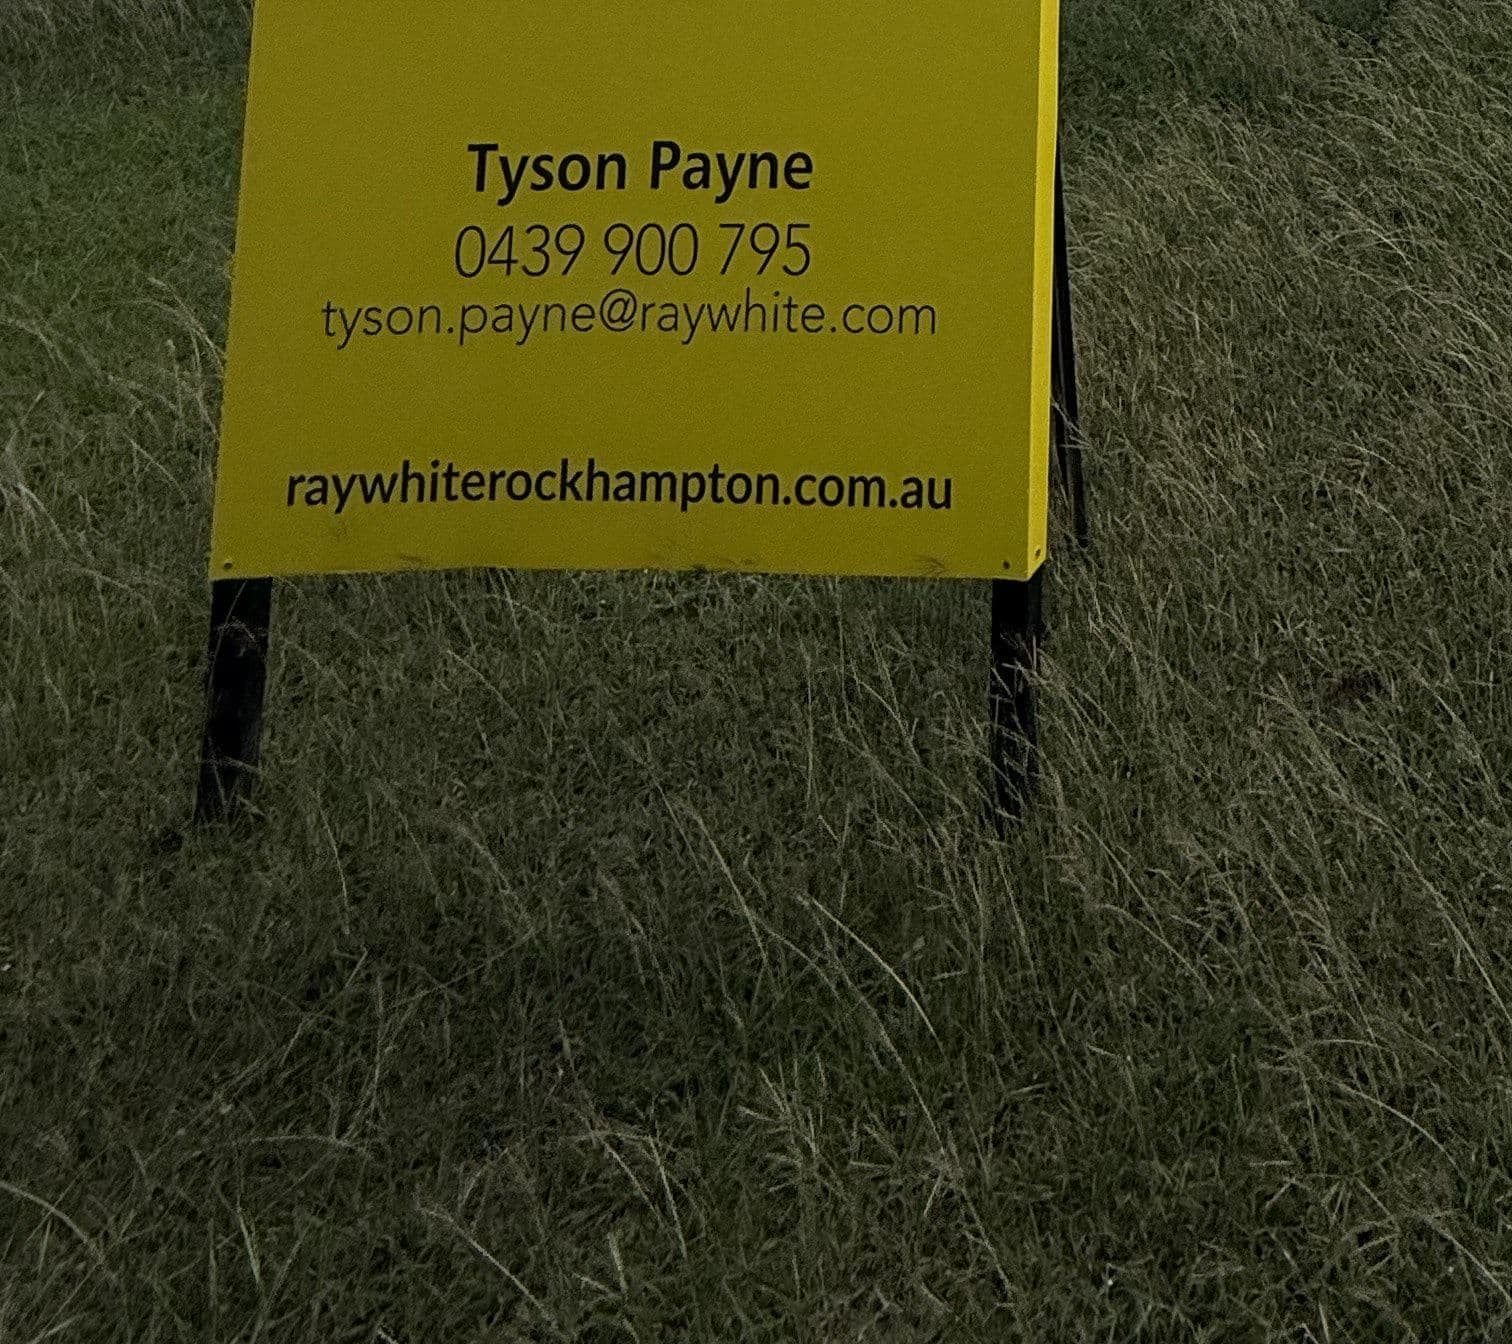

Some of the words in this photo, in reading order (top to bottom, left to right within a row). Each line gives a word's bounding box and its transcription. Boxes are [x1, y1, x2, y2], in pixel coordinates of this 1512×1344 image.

[467, 143, 626, 205] Tyson
[650, 141, 814, 203] Payne
[455, 224, 584, 277] 0439
[603, 223, 698, 276] 900
[719, 223, 812, 276] 795
[321, 289, 937, 348] tyson.payne@raywhite.com
[286, 459, 953, 513] raywhiterockhampton.com.au
